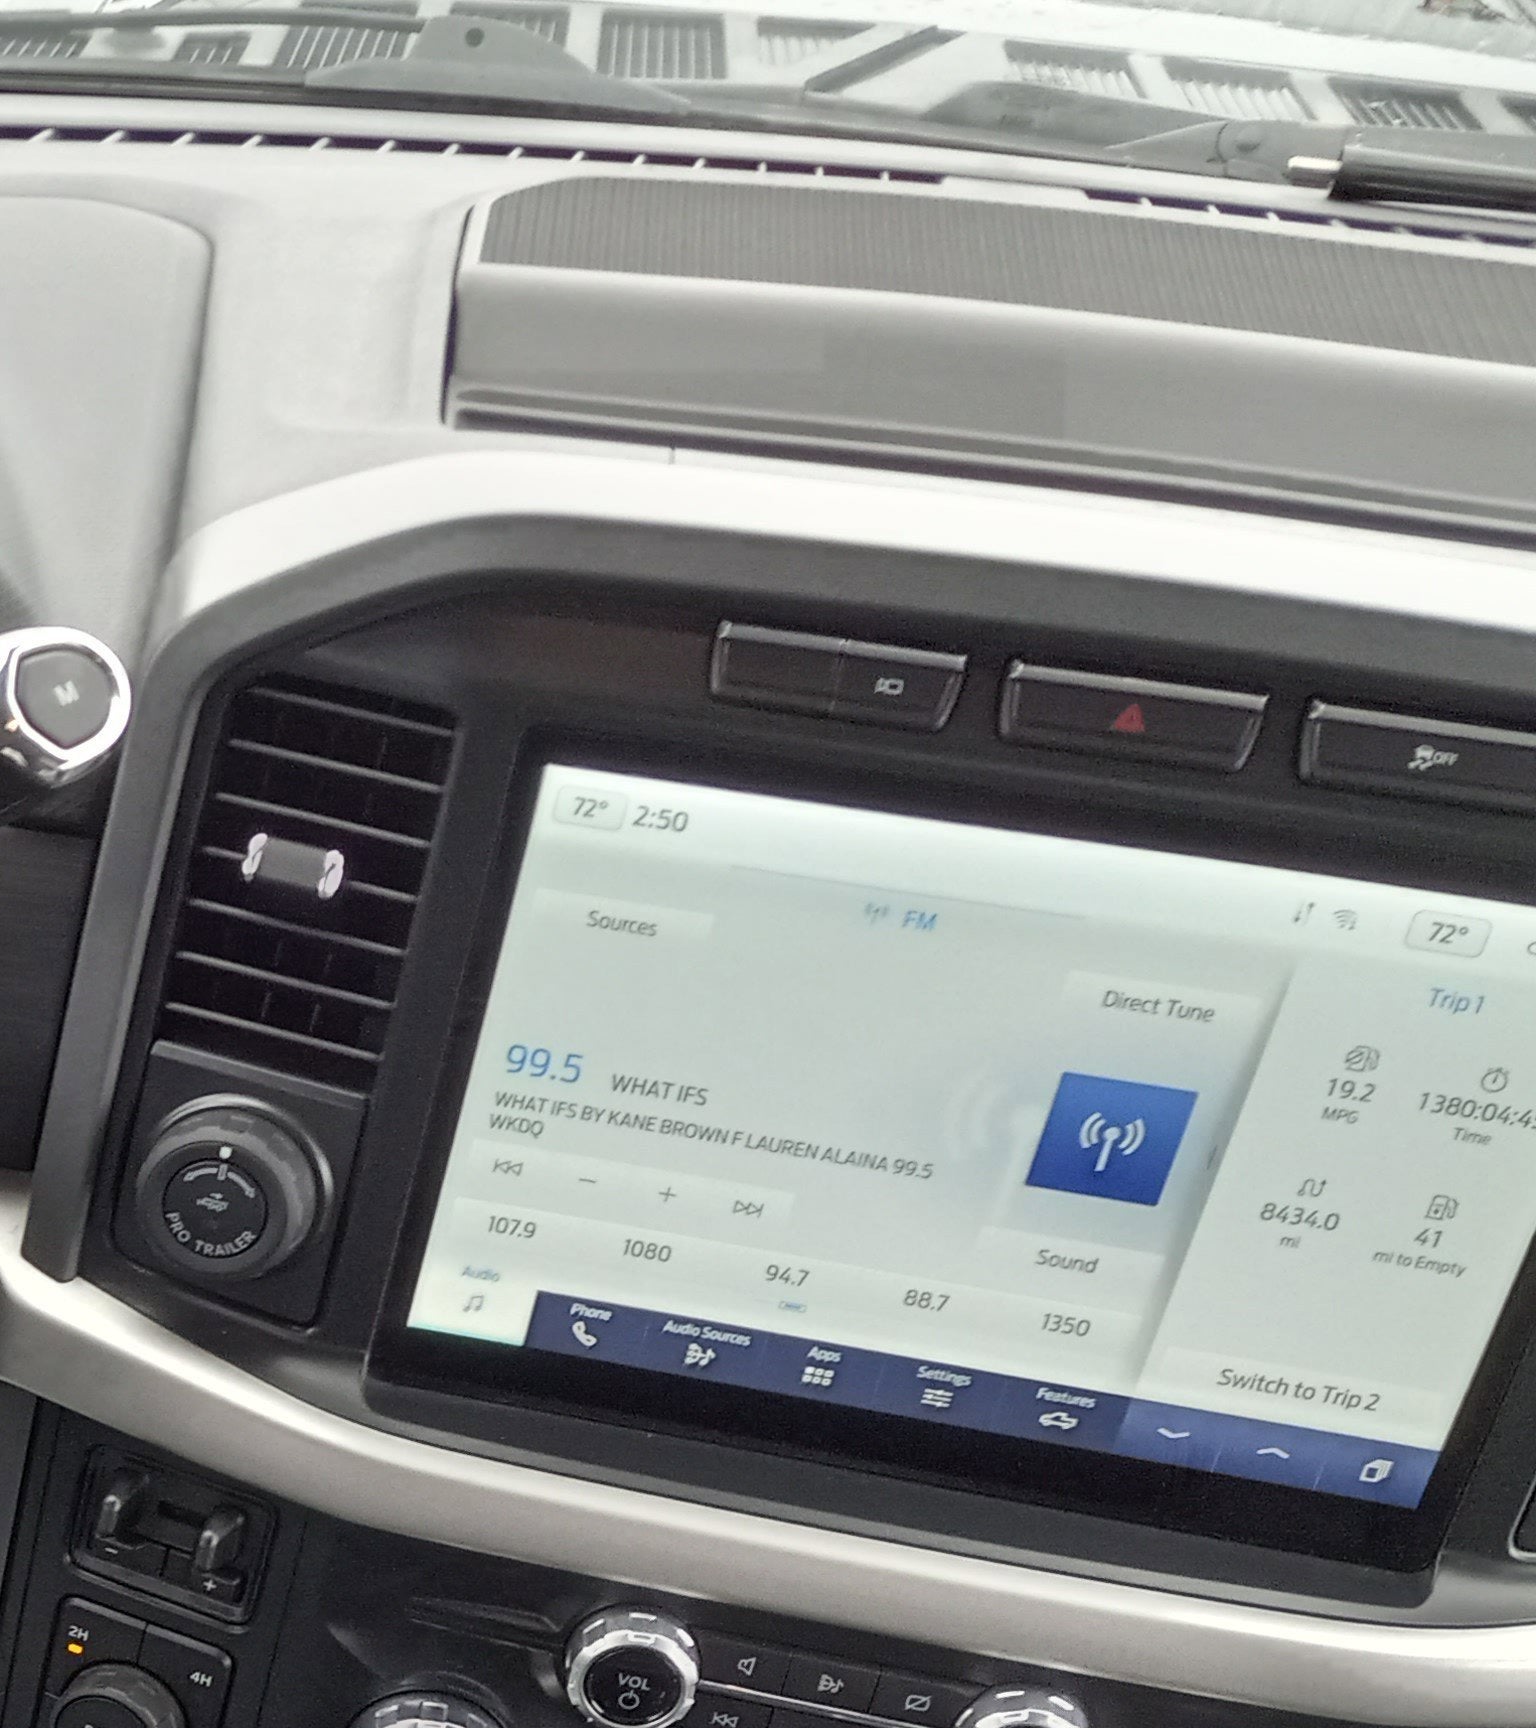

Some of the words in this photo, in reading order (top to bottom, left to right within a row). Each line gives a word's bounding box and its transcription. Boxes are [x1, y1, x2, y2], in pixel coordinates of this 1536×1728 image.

[632, 805, 689, 833] 2:50
[585, 910, 658, 937] Sources
[902, 909, 938, 931] FM
[1429, 921, 1469, 944] 72°
[1101, 990, 1162, 1016] Direct
[1167, 999, 1215, 1024] Tune
[1429, 987, 1472, 1014] Trip
[1474, 994, 1485, 1014] 1
[505, 1044, 584, 1084] 99.5
[611, 1073, 674, 1101] WHAT
[676, 1084, 710, 1107] IFS
[1327, 1078, 1377, 1104] 19.2
[1322, 1106, 1360, 1125] MPG
[495, 1090, 549, 1114] WHAT
[550, 1100, 578, 1119] IFS
[580, 1103, 606, 1124] BY
[607, 1108, 659, 1132] KANE
[660, 1118, 729, 1145] BROWN
[731, 1130, 744, 1147] F
[745, 1132, 820, 1160] LAUREN
[820, 1146, 888, 1173] ALAINA
[892, 1158, 934, 1180] 99.5
[1454, 1127, 1492, 1145] Time
[488, 1215, 536, 1239] 107.9
[1260, 1202, 1340, 1232] 8434.0
[165, 1211, 191, 1244] PRO
[194, 1229, 257, 1257] TRAILER
[1280, 1234, 1301, 1249] mi
[1413, 1227, 1443, 1249] 41
[623, 1238, 672, 1263] 1080
[1034, 1249, 1099, 1274] Sound
[461, 1264, 500, 1283] Audio
[764, 1264, 810, 1288] 94.7
[1372, 1250, 1394, 1265] mi
[1396, 1252, 1413, 1268] to
[1414, 1256, 1466, 1278] Empty
[570, 1302, 613, 1322] Phone
[903, 1289, 951, 1312] 88.7
[663, 1320, 700, 1338] Audio
[701, 1325, 751, 1348] Sources
[1040, 1313, 1091, 1337] 1350
[807, 1346, 842, 1364] Apps
[916, 1366, 973, 1388] Settings
[1036, 1387, 1096, 1409] Features
[1216, 1368, 1290, 1396] Switch
[1293, 1382, 1316, 1401] to
[1322, 1385, 1362, 1410] Trip
[1364, 1393, 1381, 1411] 2
[68, 1625, 89, 1642] 2H
[189, 1670, 213, 1688] 4H
[617, 1672, 651, 1691] VOL
